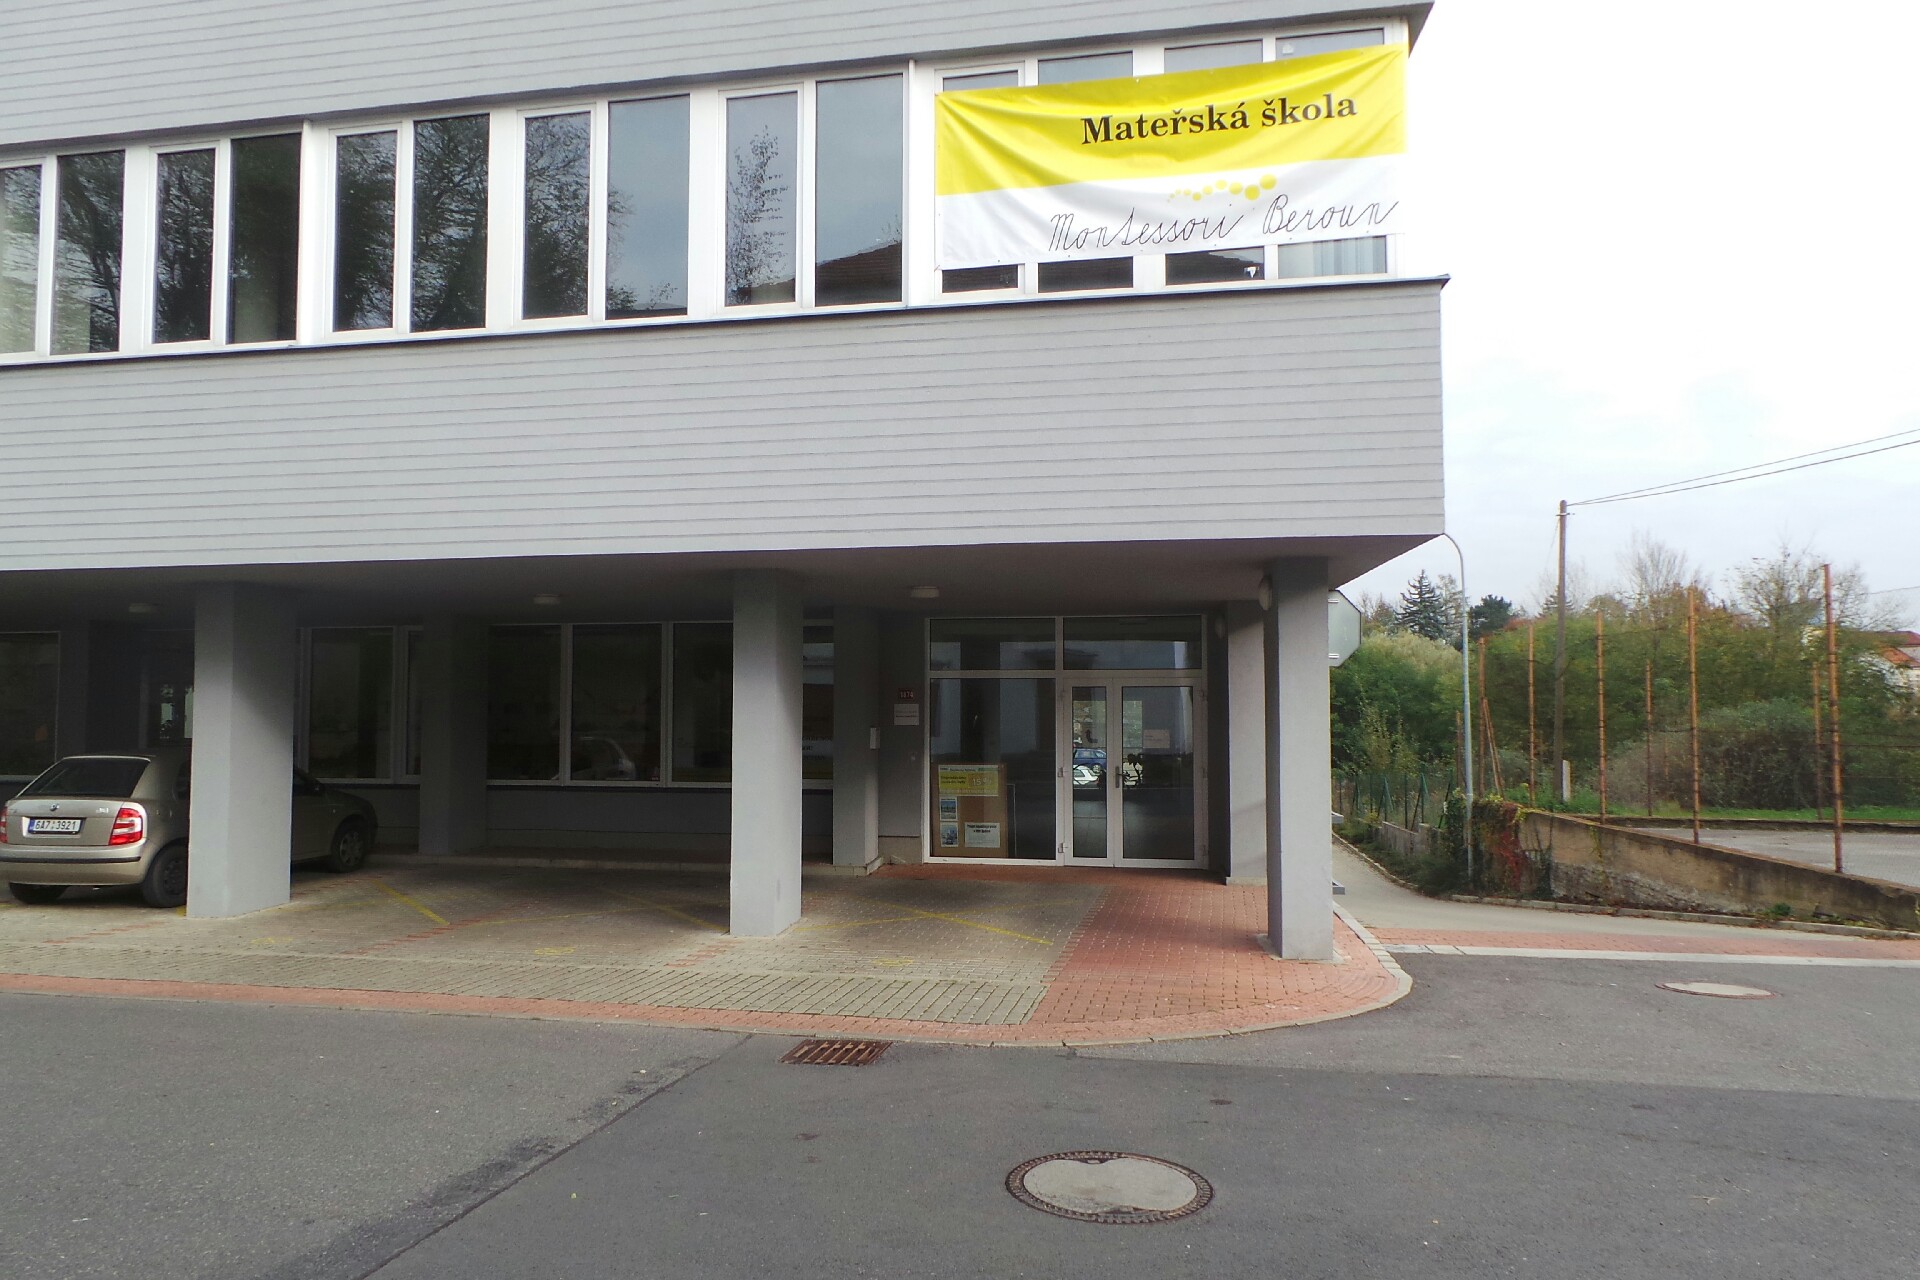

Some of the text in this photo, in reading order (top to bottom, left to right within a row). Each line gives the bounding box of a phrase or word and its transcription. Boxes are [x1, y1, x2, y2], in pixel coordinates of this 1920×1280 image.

[1080, 93, 1358, 145] Mateřská škola
[1048, 193, 1400, 252] Montessori Beroun
[56, 820, 77, 830] 3921
